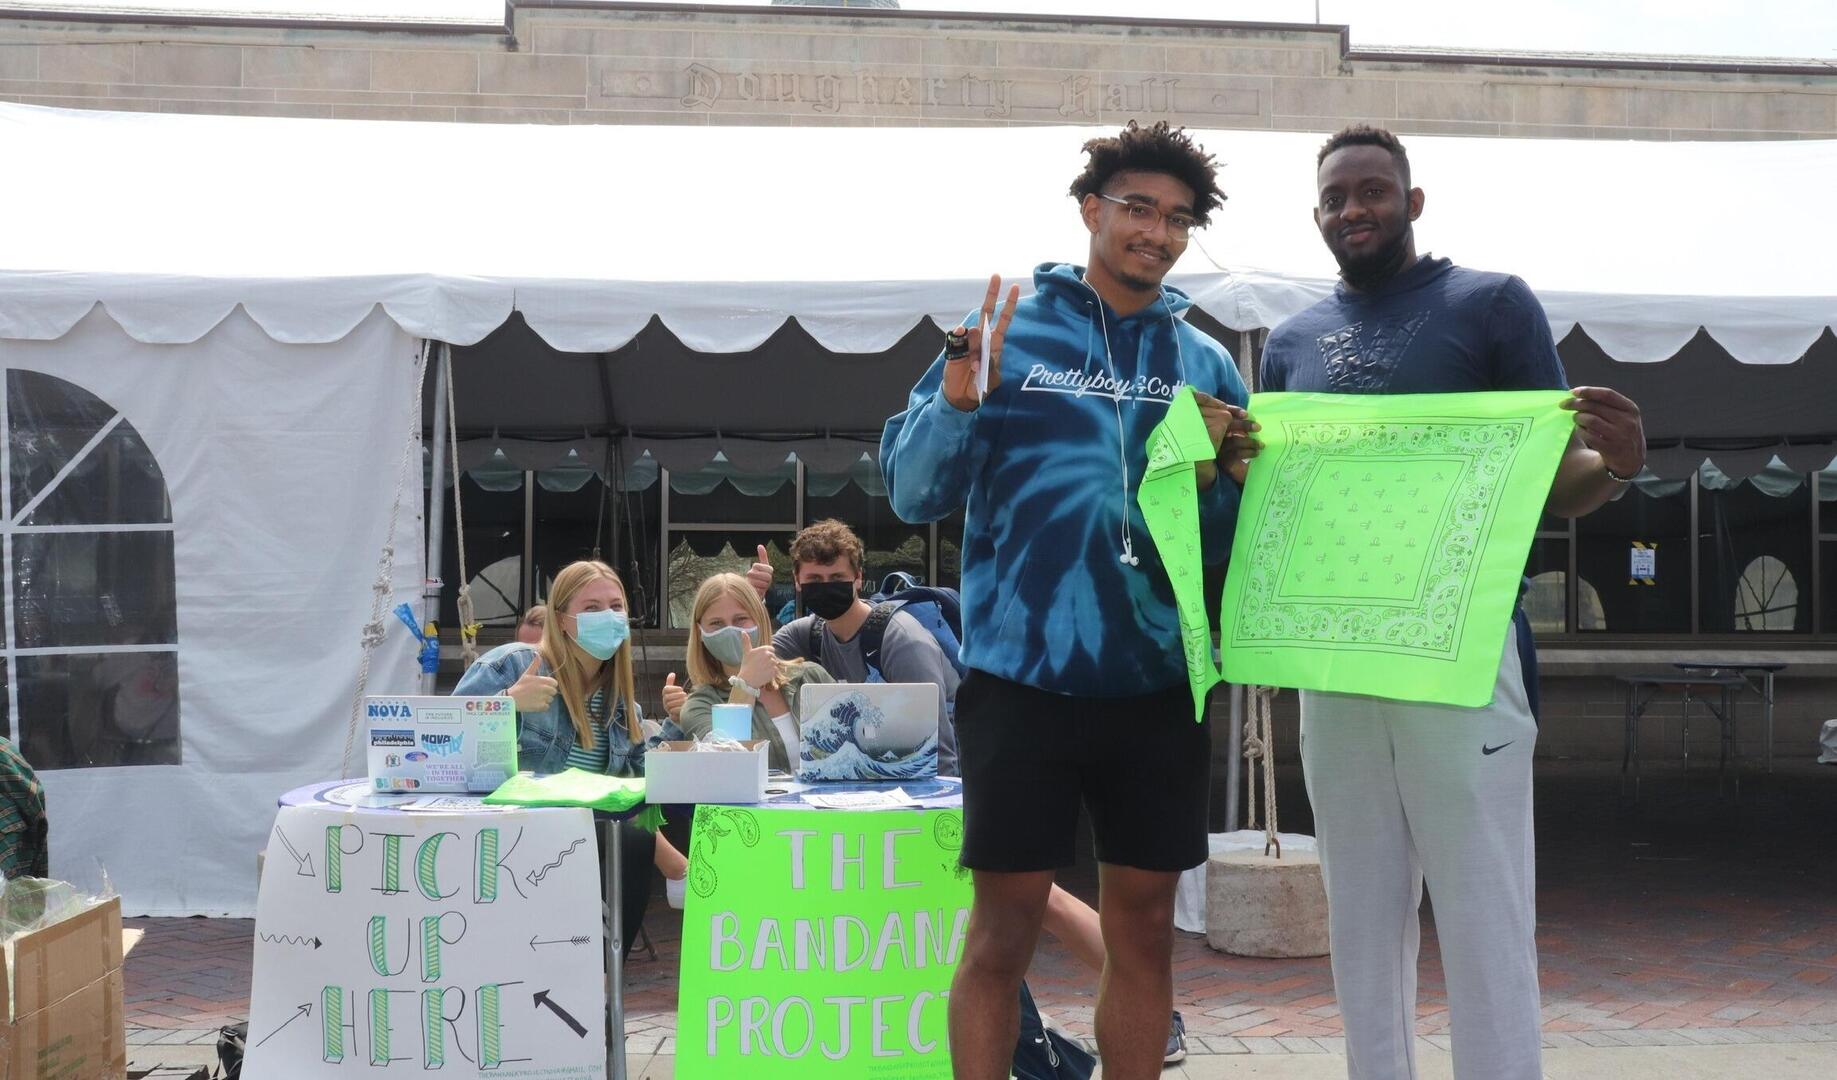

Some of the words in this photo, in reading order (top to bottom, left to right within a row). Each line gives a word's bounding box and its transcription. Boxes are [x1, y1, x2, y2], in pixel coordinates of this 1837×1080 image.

[680, 62, 1017, 117] Dougherty
[1058, 74, 1180, 118] Hall
[368, 705, 412, 718] NOVA
[421, 734, 451, 745] NOVA
[326, 824, 528, 903] PICK
[775, 828, 923, 891] THE
[366, 911, 467, 983] UP
[321, 981, 533, 1070] HERE
